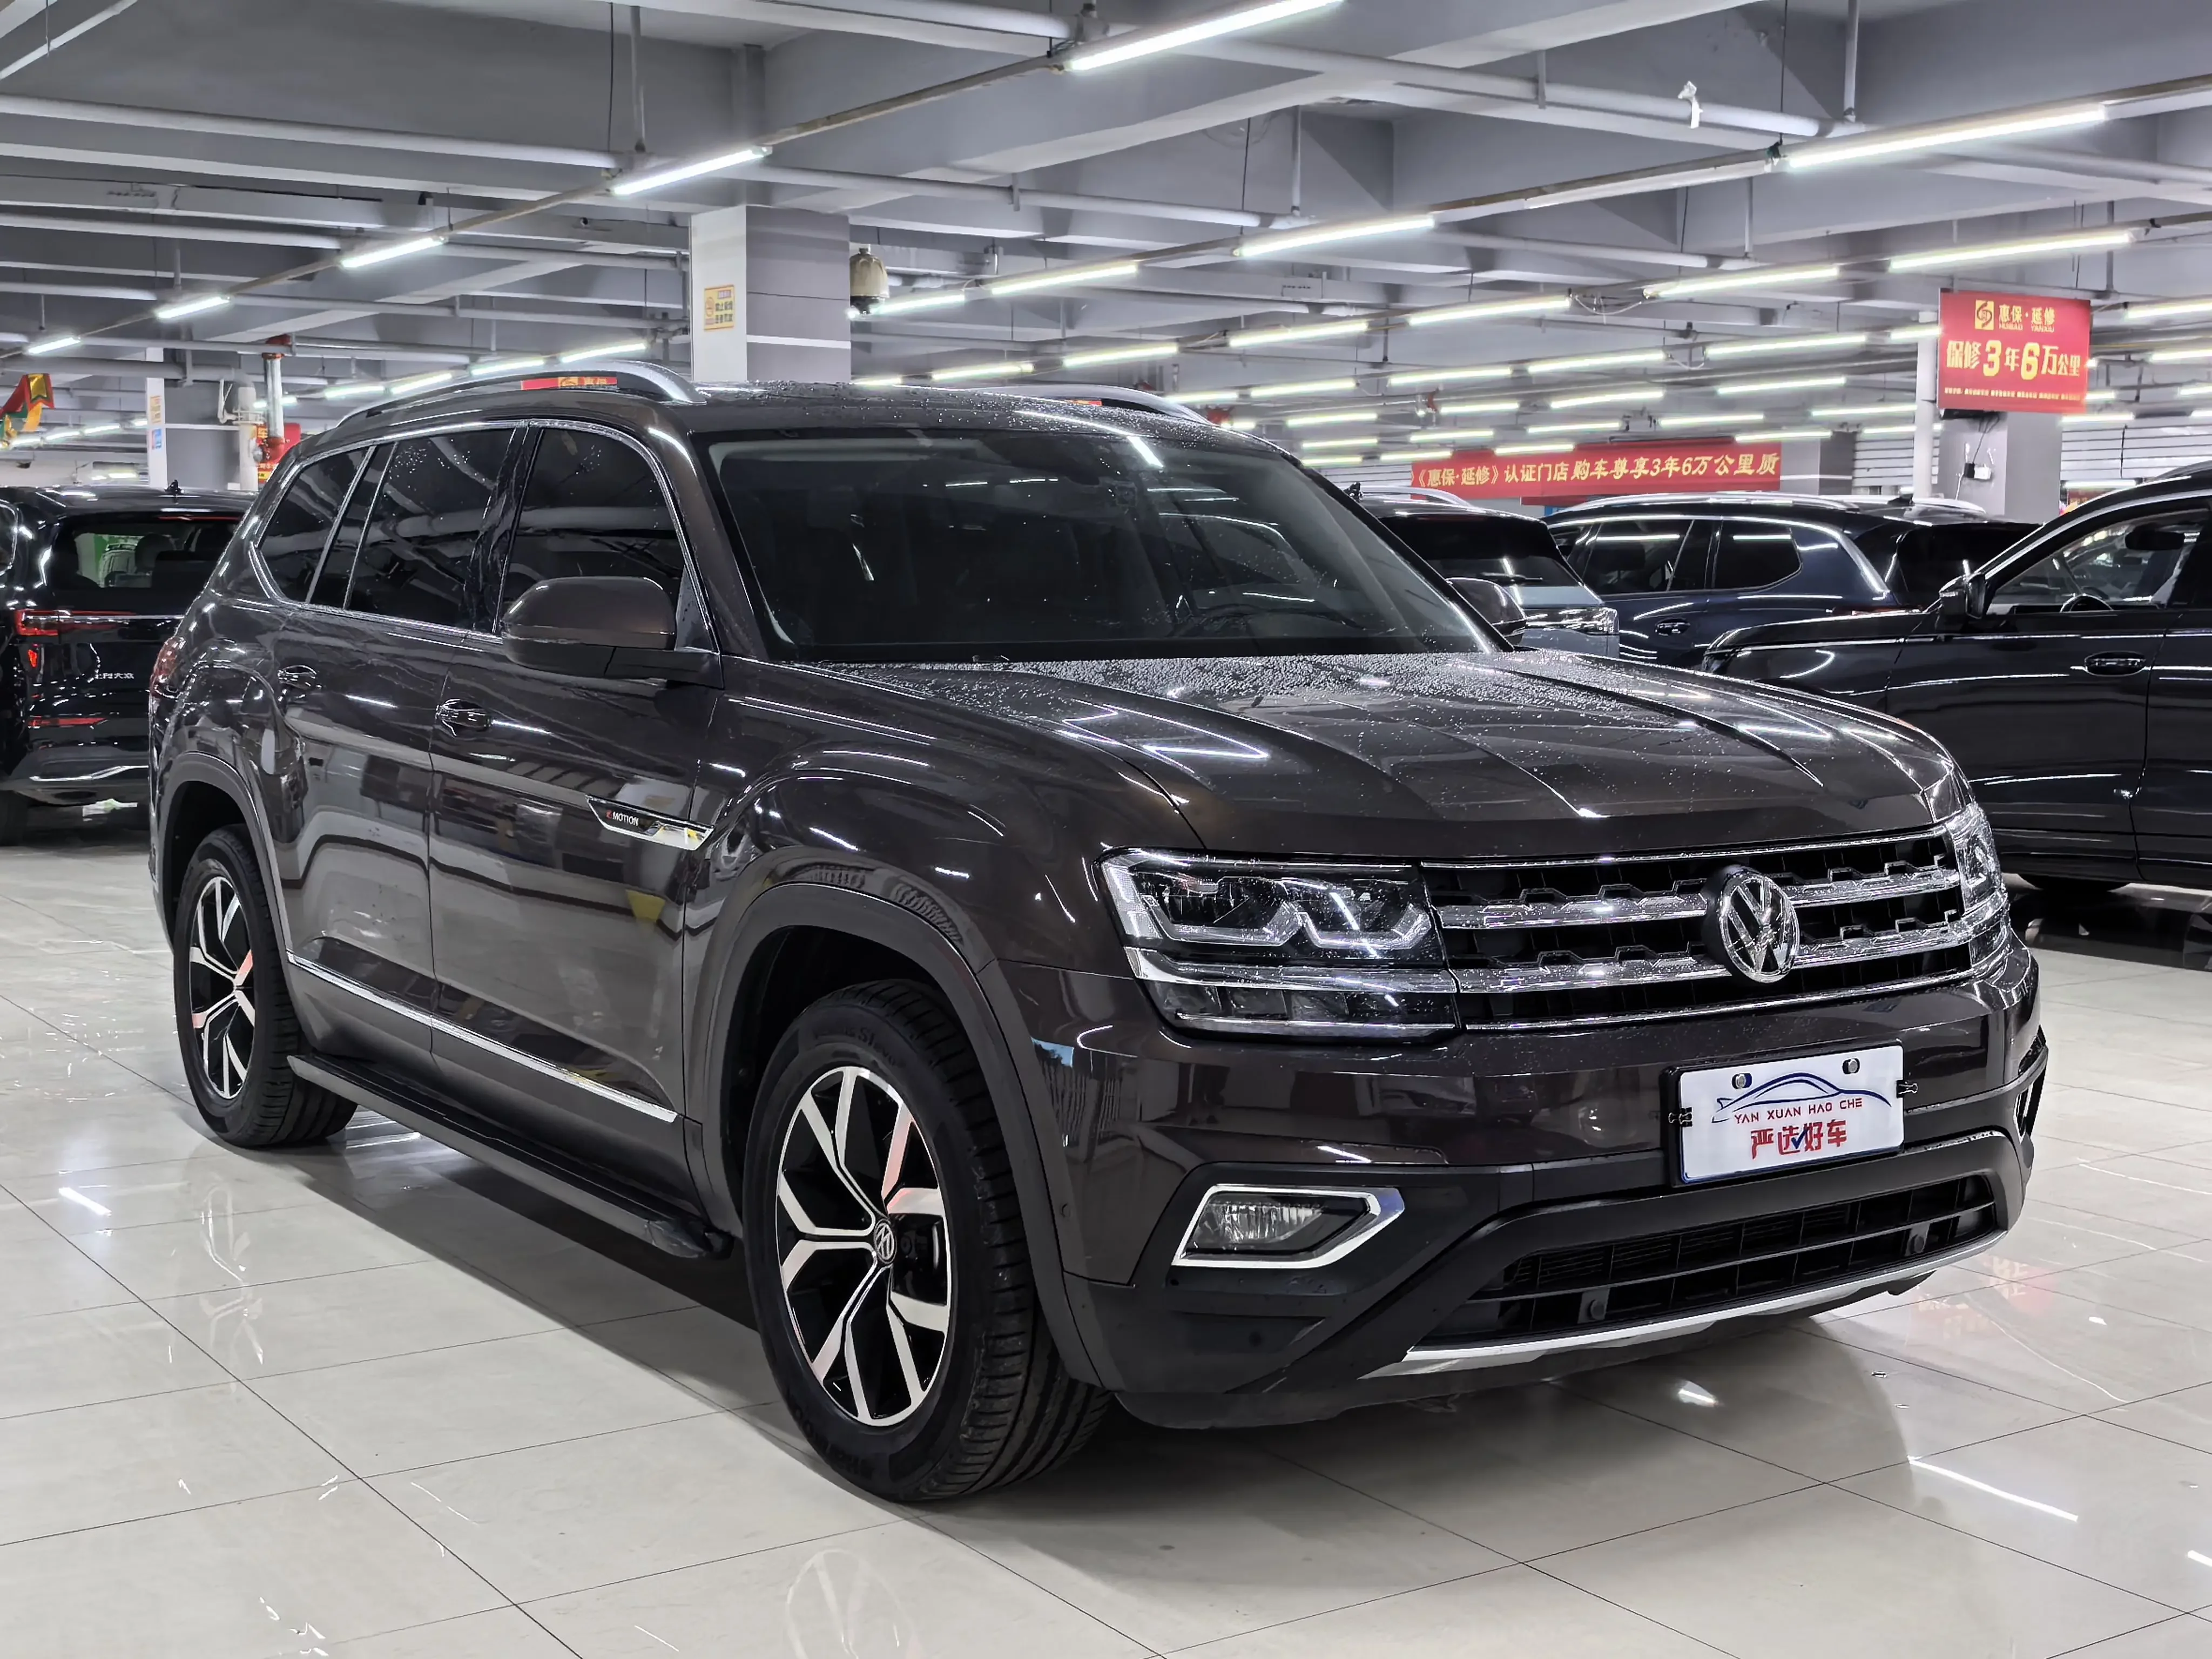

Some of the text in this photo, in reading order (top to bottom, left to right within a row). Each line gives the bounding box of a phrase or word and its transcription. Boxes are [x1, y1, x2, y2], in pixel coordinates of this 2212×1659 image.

[1946, 340, 2081, 380] 保修3年6万公里
[1735, 1097, 1863, 1124] YAN XUAN HAO CHE
[1751, 1119, 1847, 1159] 严选好车
